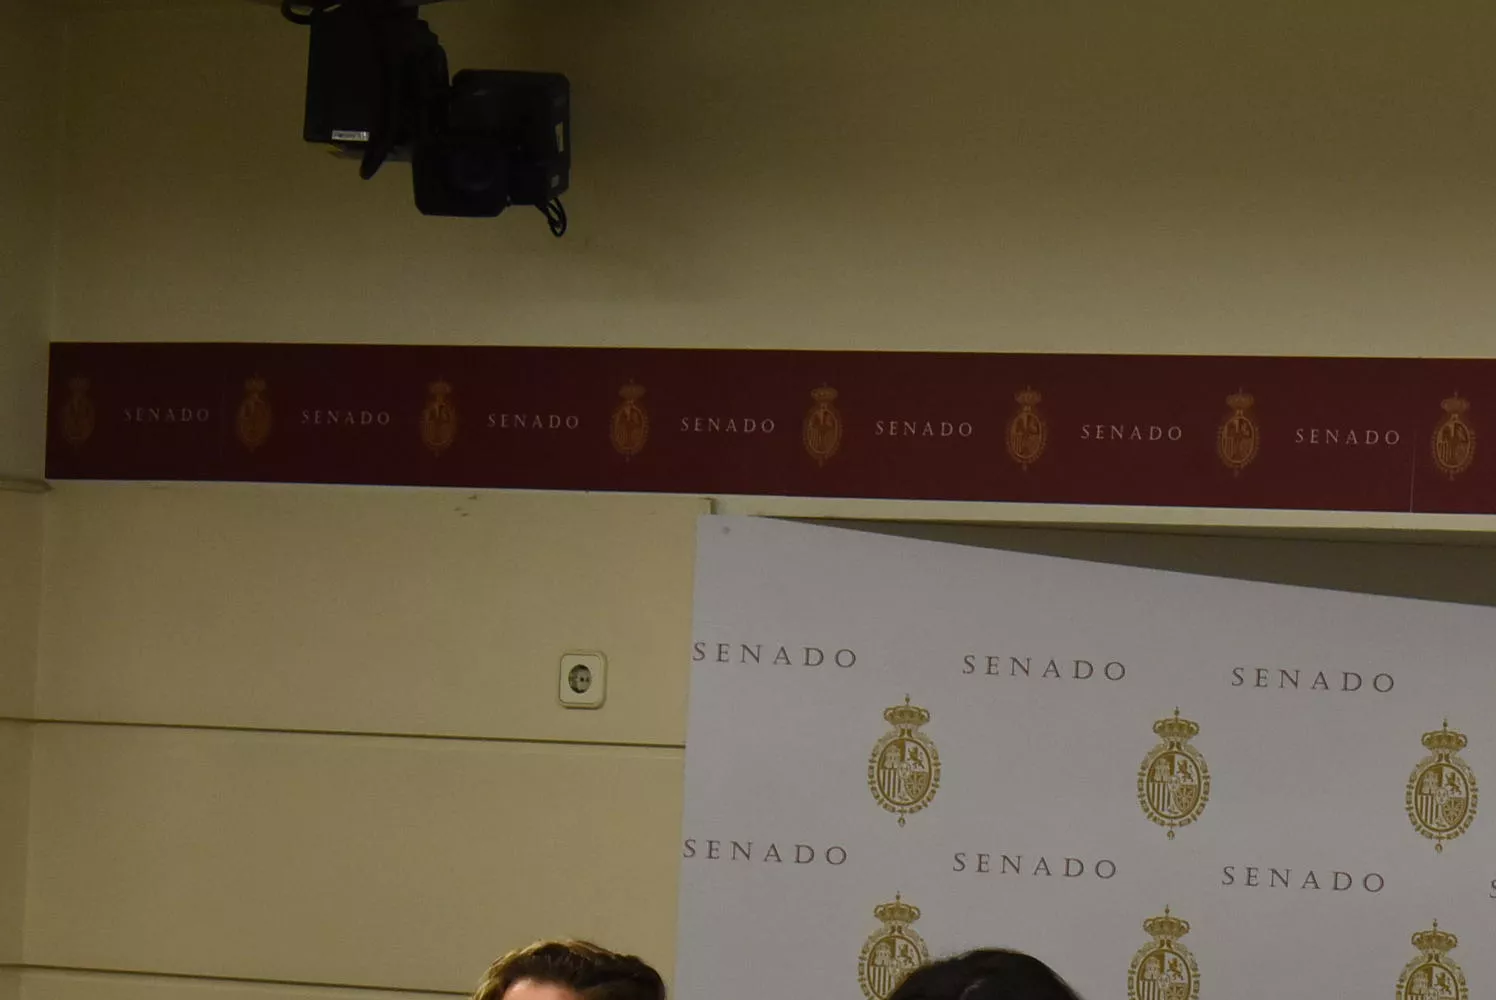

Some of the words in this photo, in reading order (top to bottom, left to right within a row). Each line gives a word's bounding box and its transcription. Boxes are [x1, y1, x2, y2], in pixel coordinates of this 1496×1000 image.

[123, 407, 209, 422] SENADO
[300, 409, 390, 426] SENADO
[487, 413, 579, 430] SENADO
[679, 417, 775, 434] SENADO
[874, 420, 973, 437] SENADO
[1079, 424, 1182, 441] SENADO
[1294, 428, 1400, 445] SENADO
[693, 643, 856, 668] SENADO
[963, 655, 1125, 680] SENADO
[1232, 668, 1394, 692] SENADO
[683, 839, 846, 865] SENADO
[953, 853, 1116, 879] SENADO
[1222, 866, 1384, 892] SENADO
